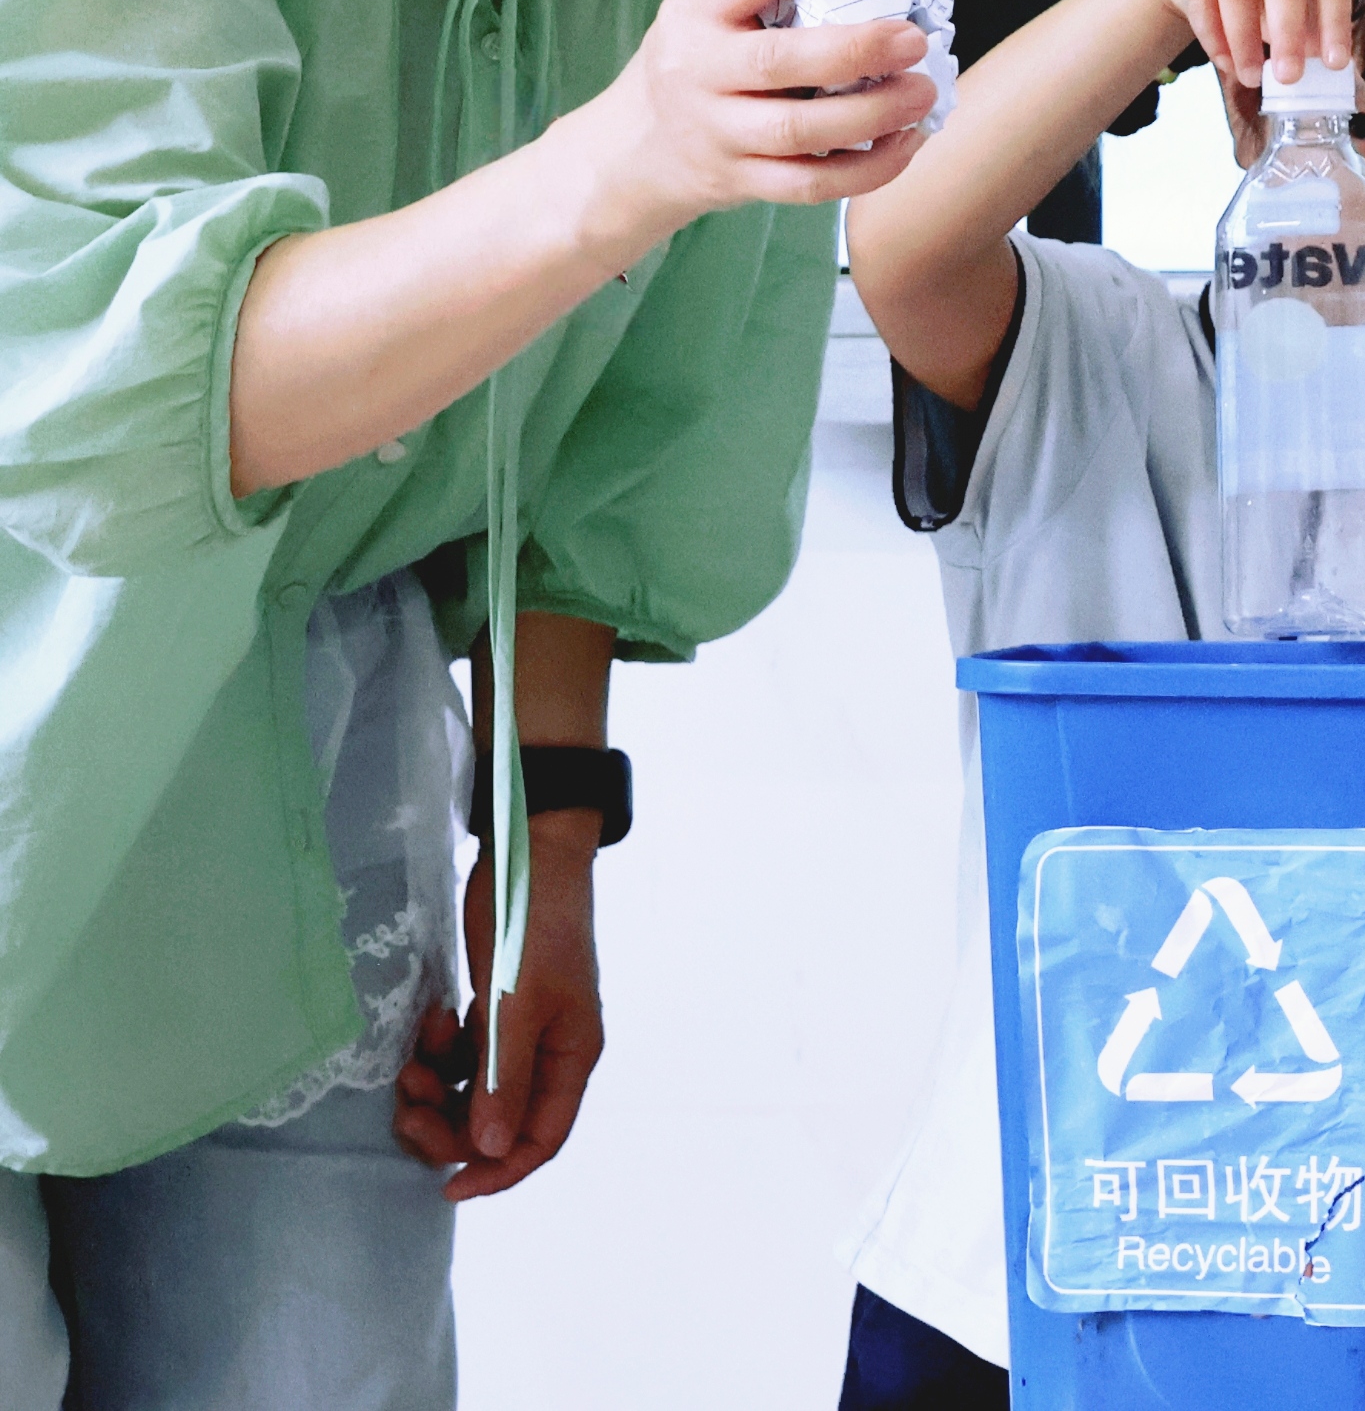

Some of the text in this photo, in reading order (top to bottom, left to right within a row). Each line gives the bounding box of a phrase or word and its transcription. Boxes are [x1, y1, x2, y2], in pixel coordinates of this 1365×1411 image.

[1084, 1154, 1362, 1232] 可回收物
[1116, 1235, 1331, 1284] Recyclable
